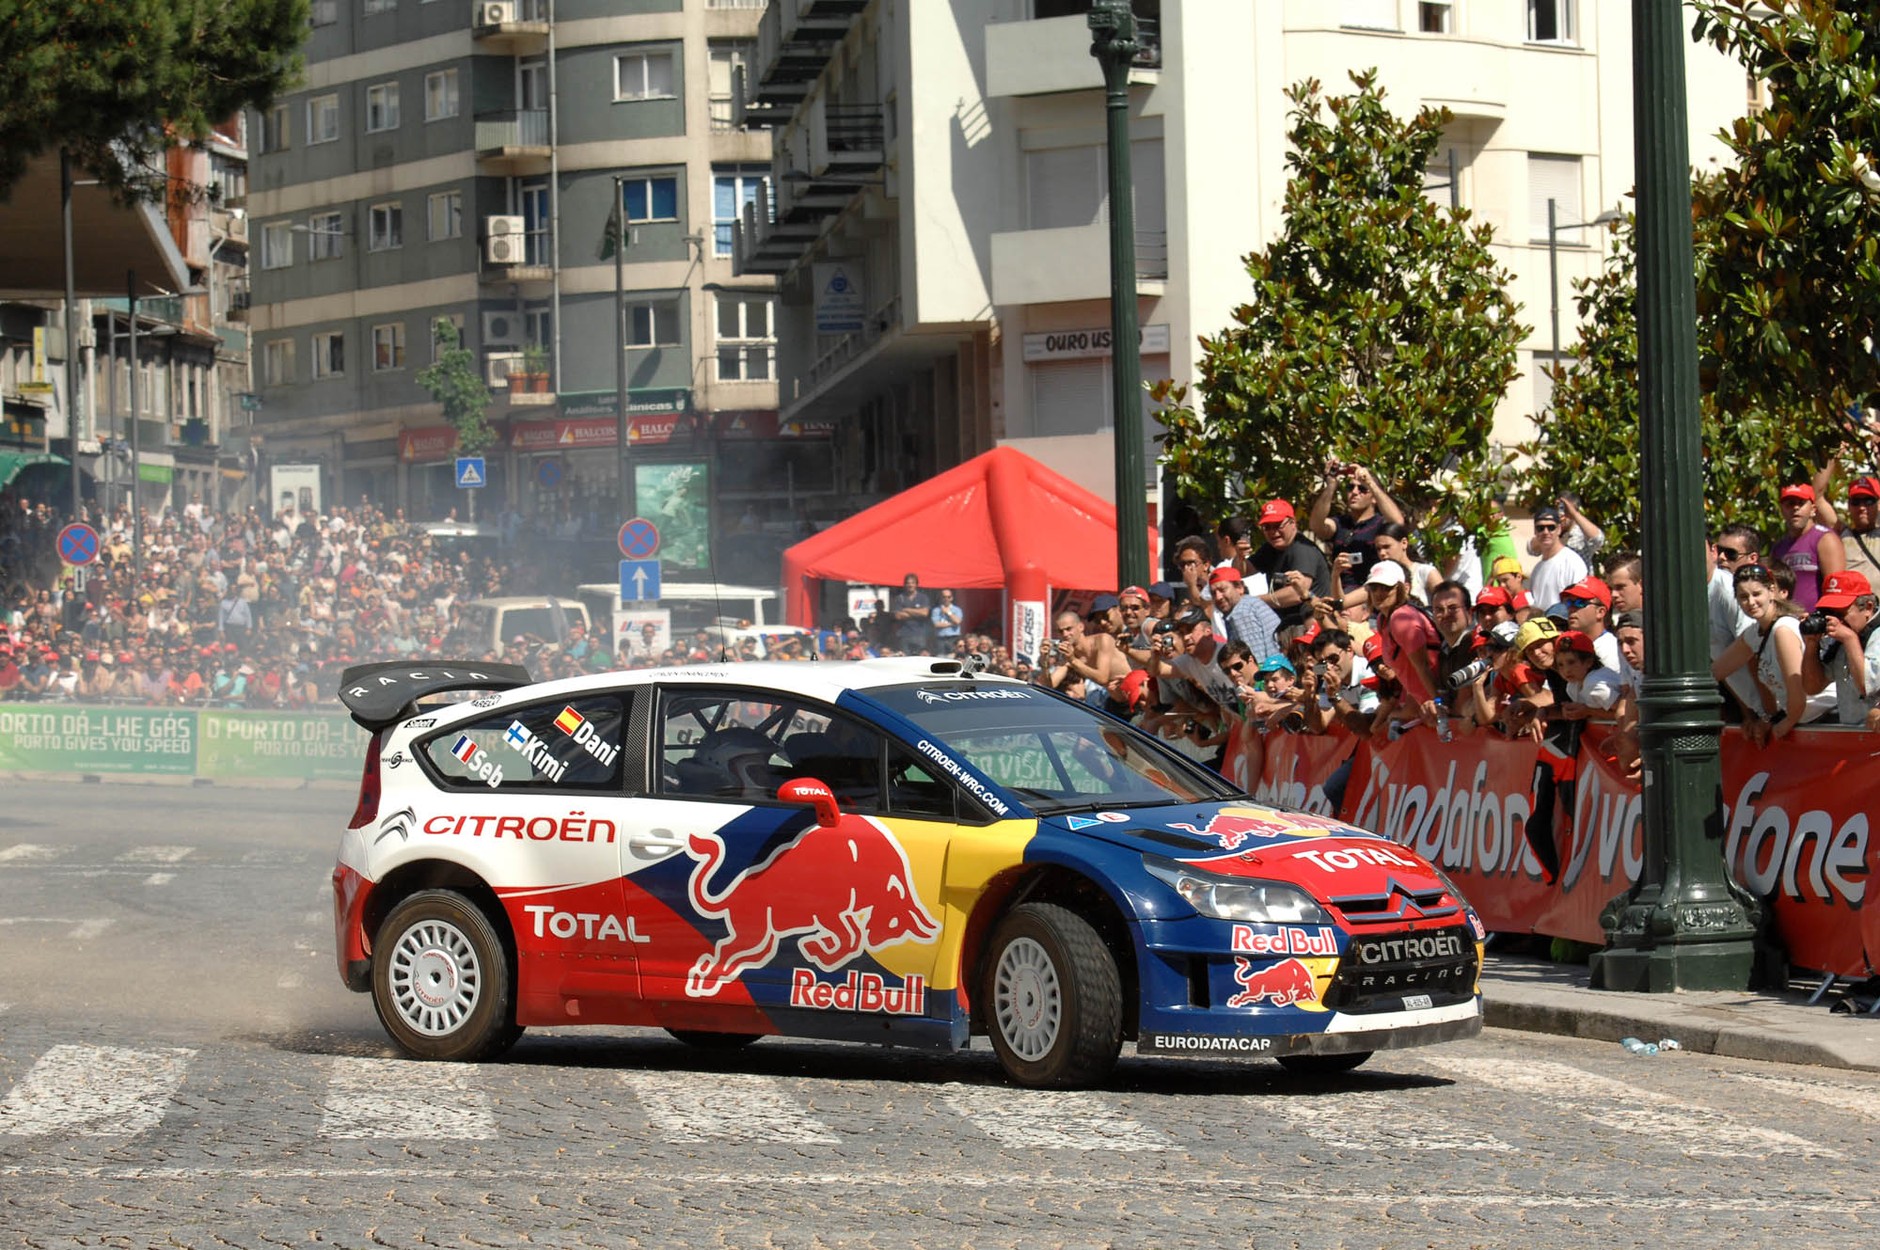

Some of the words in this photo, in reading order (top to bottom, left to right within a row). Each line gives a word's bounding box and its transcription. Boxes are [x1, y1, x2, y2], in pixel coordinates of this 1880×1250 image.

[1046, 334, 1088, 351] OURO
[0, 713, 56, 733] ORTO
[62, 711, 144, 737] DÁ-LHE
[149, 712, 191, 738] GÁS
[226, 718, 296, 741] PORTO
[303, 717, 372, 743] DÁ-LH
[14, 734, 61, 750] PORTO
[65, 735, 108, 752] GIVES
[111, 736, 141, 753] YOU
[145, 738, 191, 754] SPEED
[254, 741, 300, 756] PORTO
[305, 742, 347, 758] GIVES
[572, 720, 622, 767] Dani
[468, 749, 504, 789] Seb
[521, 735, 569, 784] Kimi
[793, 787, 828, 796] TOTAL
[916, 739, 1009, 817] CITROEN-WRC.COM
[423, 810, 616, 843] CITROËN
[1384, 759, 1543, 878] vodafon
[1292, 848, 1418, 873] TOTAL
[524, 904, 651, 943] TOTAL
[1232, 925, 1290, 953] Red
[1291, 926, 1338, 955] Bull
[1362, 966, 1464, 986] RACING
[790, 968, 858, 1011] Red
[859, 972, 925, 1015] Bull
